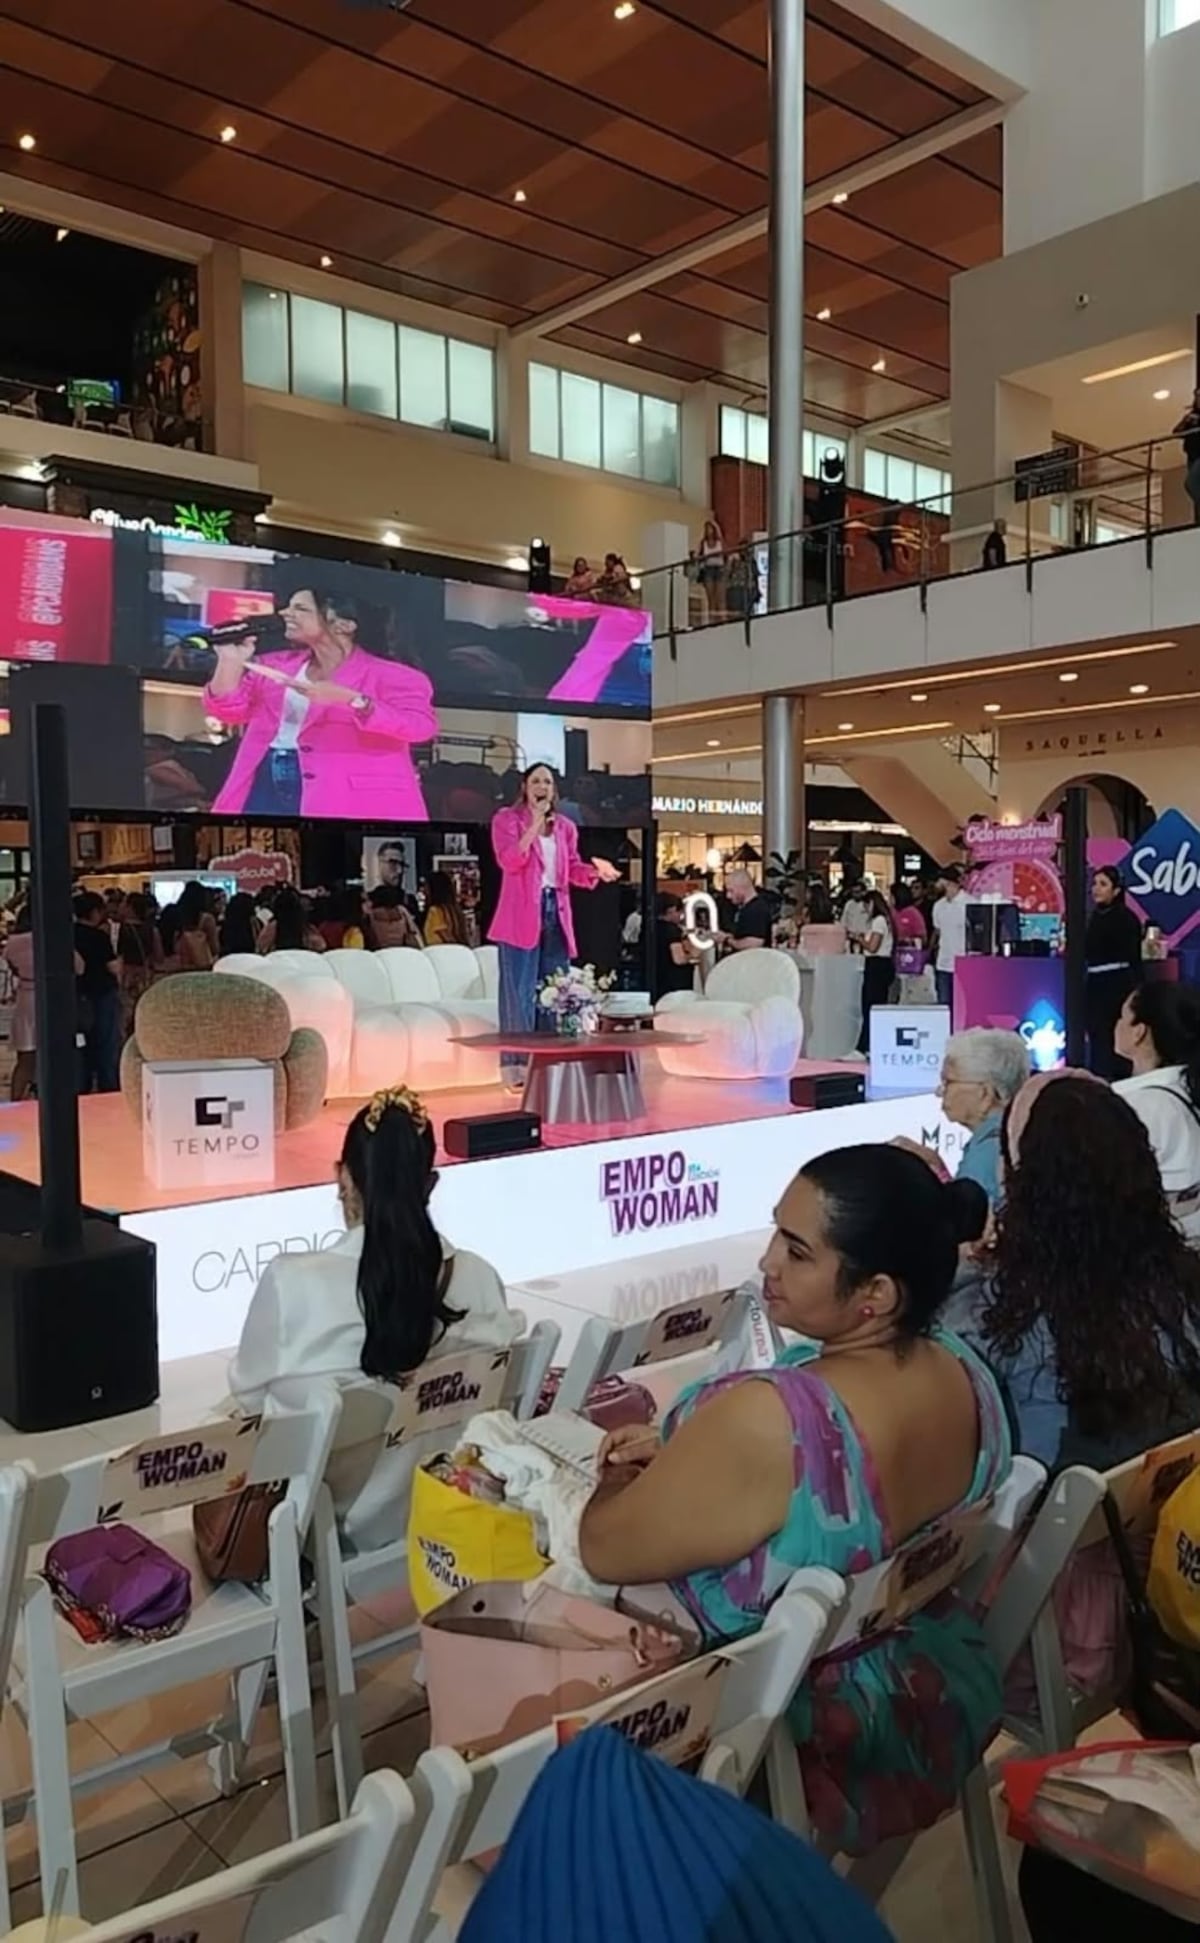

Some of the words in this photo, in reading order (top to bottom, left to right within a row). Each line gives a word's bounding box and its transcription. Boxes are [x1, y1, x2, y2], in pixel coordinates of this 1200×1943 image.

[1026, 727, 1163, 751] SAQUELLA
[652, 797, 696, 812] MARIO
[1128, 841, 1200, 896] Sab
[880, 1053, 939, 1066] TEMPO
[172, 1133, 260, 1156] TEMPO
[602, 1151, 686, 1198] EMPO
[612, 1181, 719, 1235] WOMAN
[416, 1371, 464, 1400] EMPO
[418, 1383, 482, 1415] WOMAN
[136, 1441, 204, 1472] EMPO
[141, 1451, 228, 1489] WOMAN
